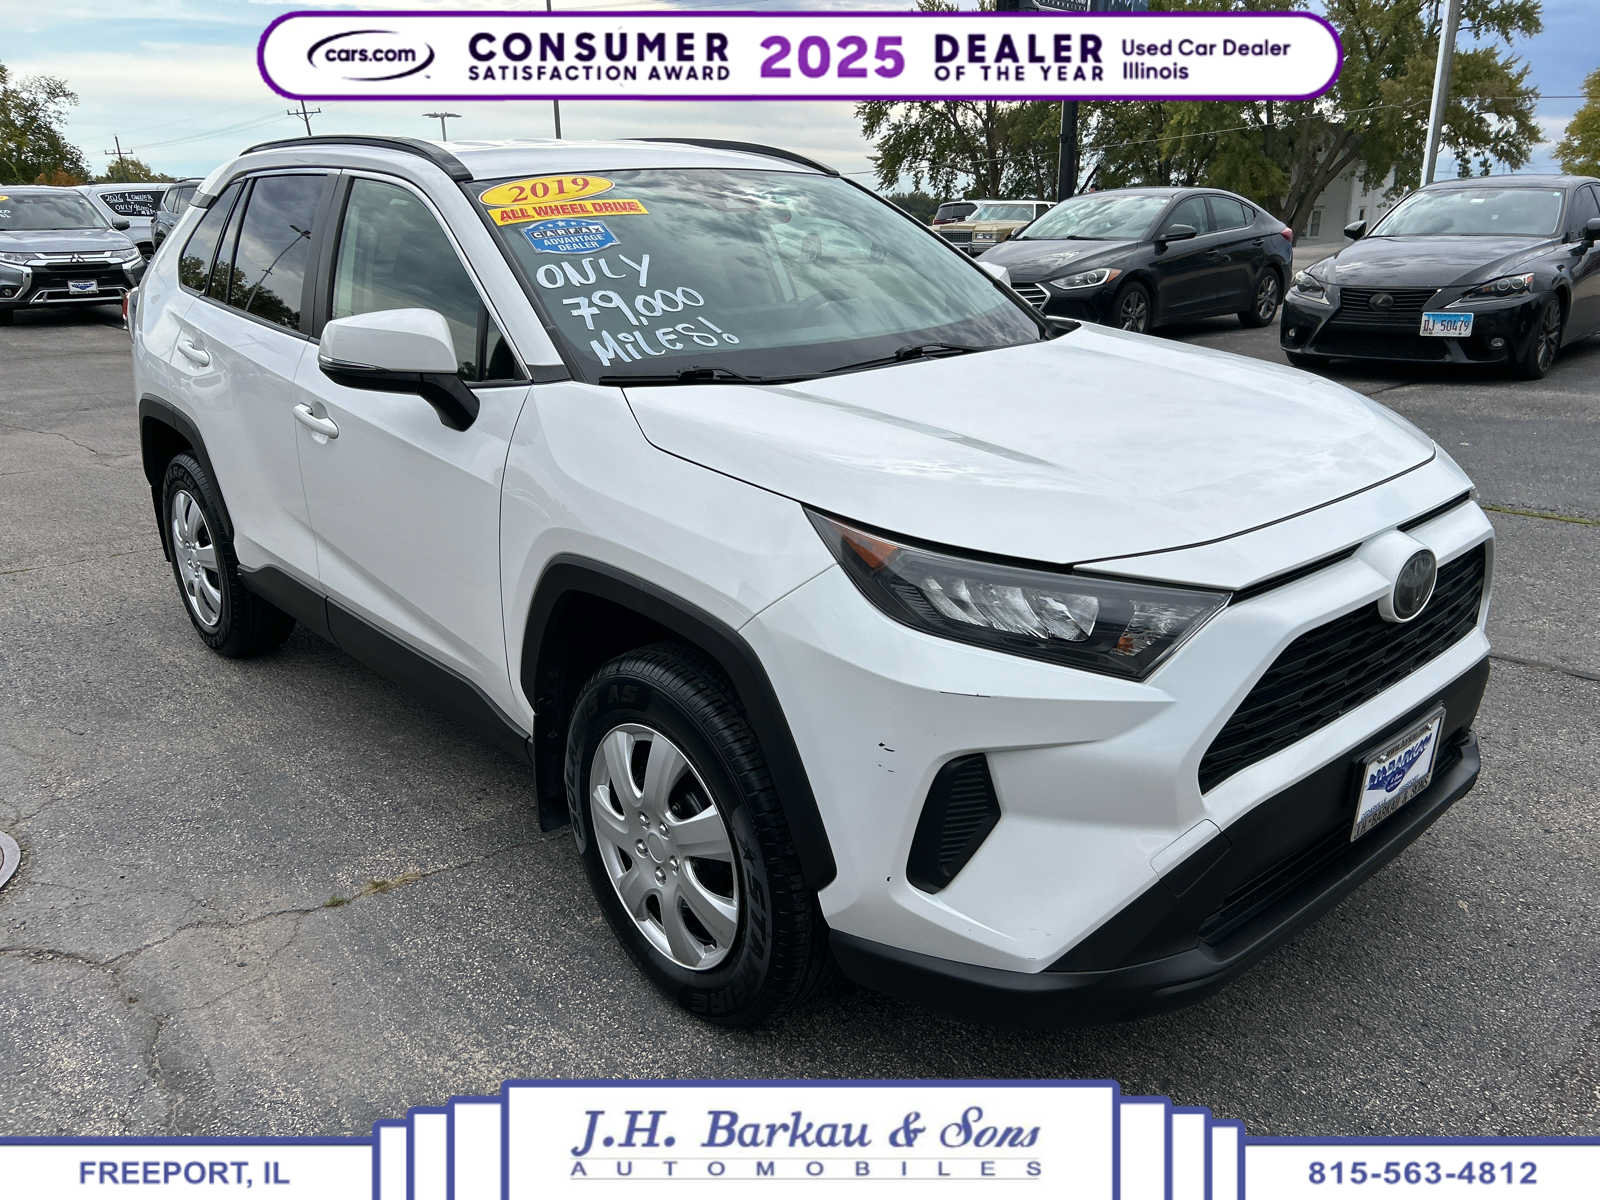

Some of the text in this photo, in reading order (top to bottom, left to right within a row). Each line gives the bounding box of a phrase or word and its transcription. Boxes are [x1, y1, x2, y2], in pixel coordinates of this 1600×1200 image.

[507, 176, 591, 203] 2019
[499, 201, 642, 223] ALL WHEEL DRIVE
[530, 225, 605, 240] CARFAX
[543, 233, 604, 246] ADVANTAGE
[557, 240, 600, 252] DEALER
[536, 253, 650, 289] ONLY
[562, 286, 705, 330] 79,000
